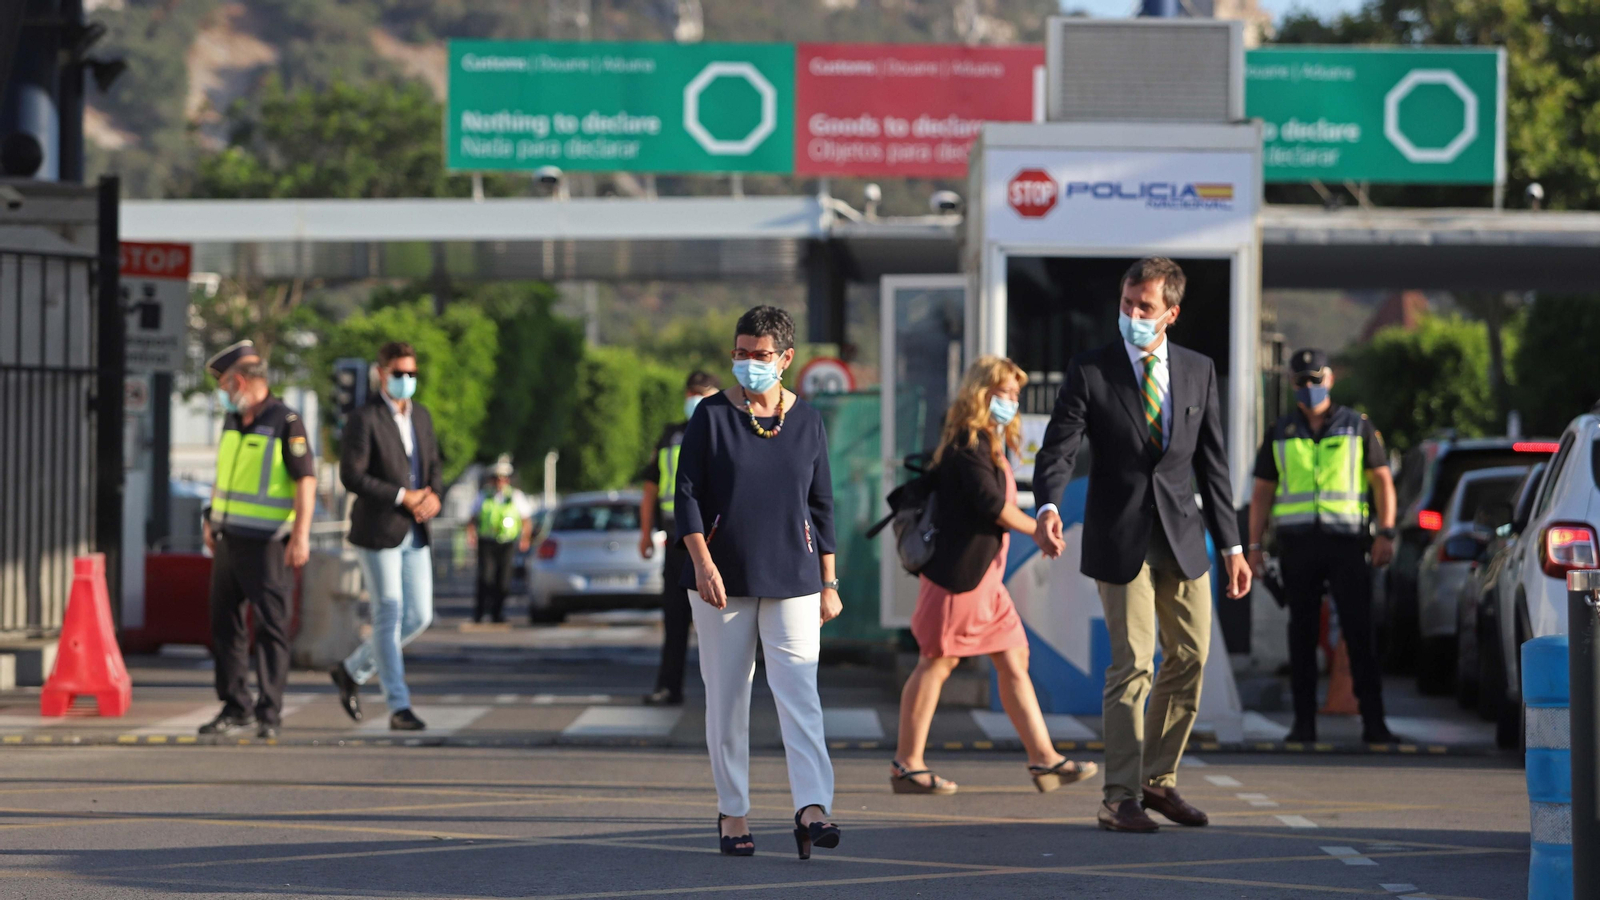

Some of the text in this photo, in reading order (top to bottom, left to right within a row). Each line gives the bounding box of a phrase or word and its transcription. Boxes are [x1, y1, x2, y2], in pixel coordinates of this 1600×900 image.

[461, 54, 527, 72] Customs
[538, 54, 591, 72] Douane
[809, 57, 876, 76] Customs
[461, 110, 662, 138] Nothing to declare
[808, 113, 882, 138] Goods
[884, 115, 910, 138] to
[1281, 117, 1362, 142] declare
[461, 136, 642, 163] Nada para declarar
[808, 138, 885, 166] Objetos
[886, 142, 933, 166] para
[1011, 180, 1056, 206] STOP
[1066, 182, 1196, 199] POLICIA
